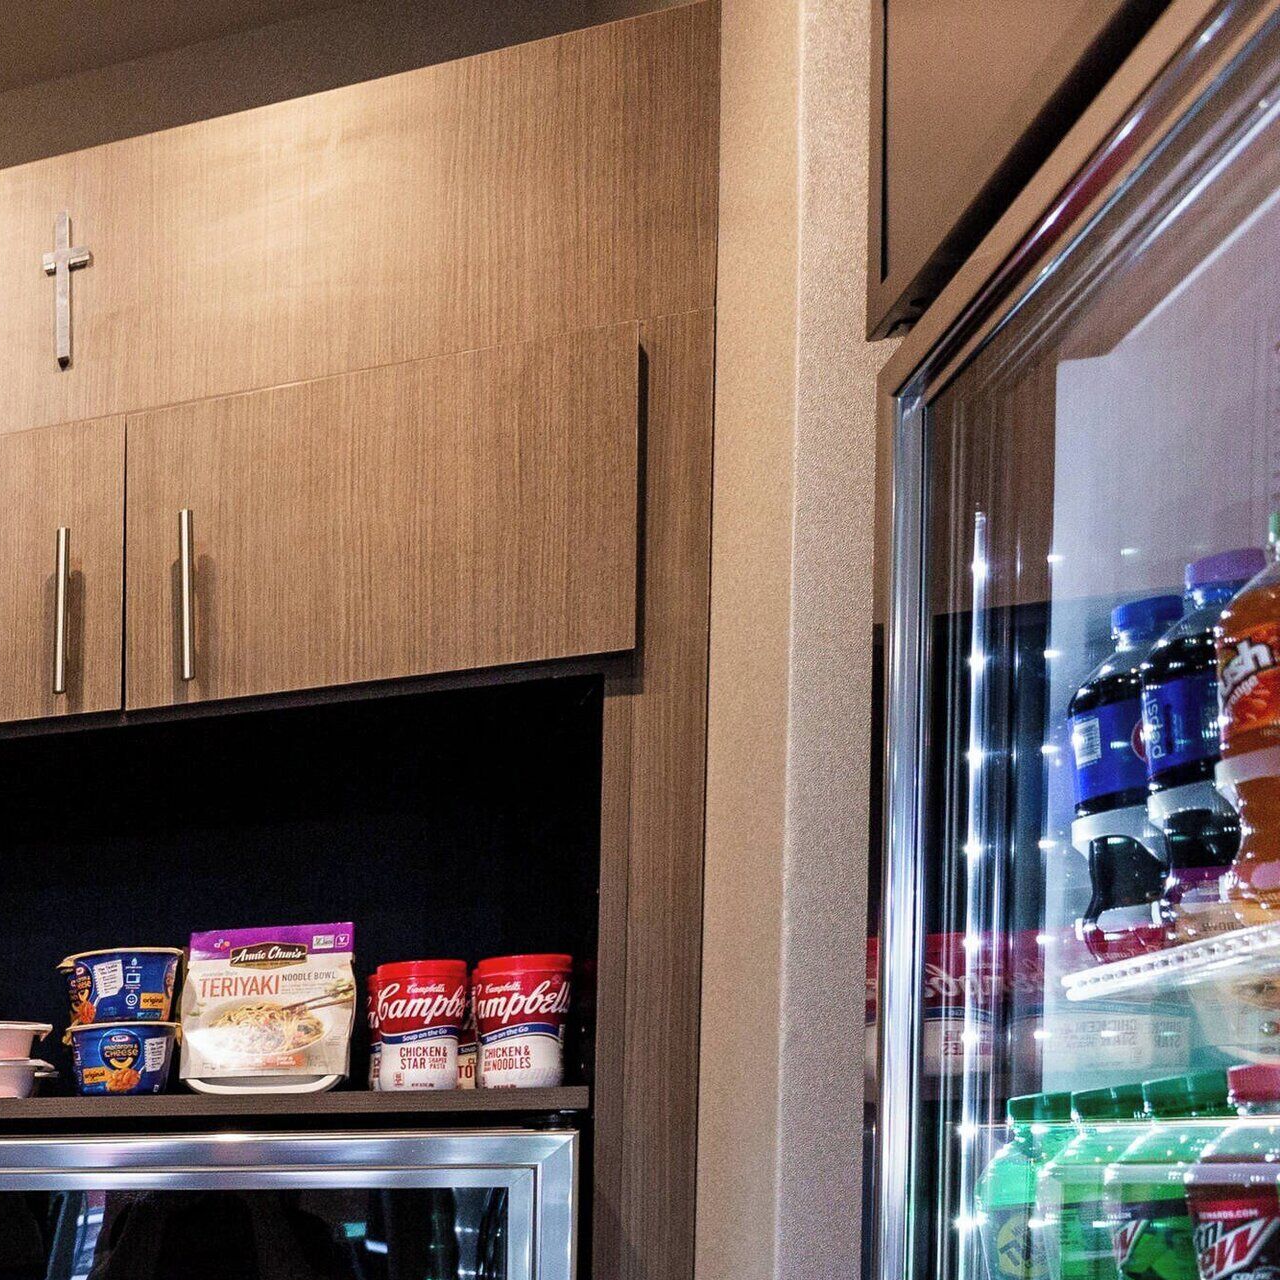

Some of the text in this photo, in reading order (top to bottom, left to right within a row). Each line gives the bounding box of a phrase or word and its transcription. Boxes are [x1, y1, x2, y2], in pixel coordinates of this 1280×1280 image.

[1146, 698, 1167, 760] pepsi
[232, 945, 306, 964] Annie Chun's
[199, 971, 337, 998] TERIYAKI NOODLE BOWL
[402, 1034, 418, 1042] Soup
[428, 1029, 438, 1037] the
[438, 1028, 448, 1036] Go
[506, 1028, 518, 1036] the
[518, 1025, 529, 1034] Go
[399, 1047, 441, 1058] CHICKEN
[484, 1045, 522, 1059] CHICKEN
[400, 1058, 426, 1071] STAR
[491, 1056, 532, 1071] NOODLES
[84, 1070, 106, 1079] original
